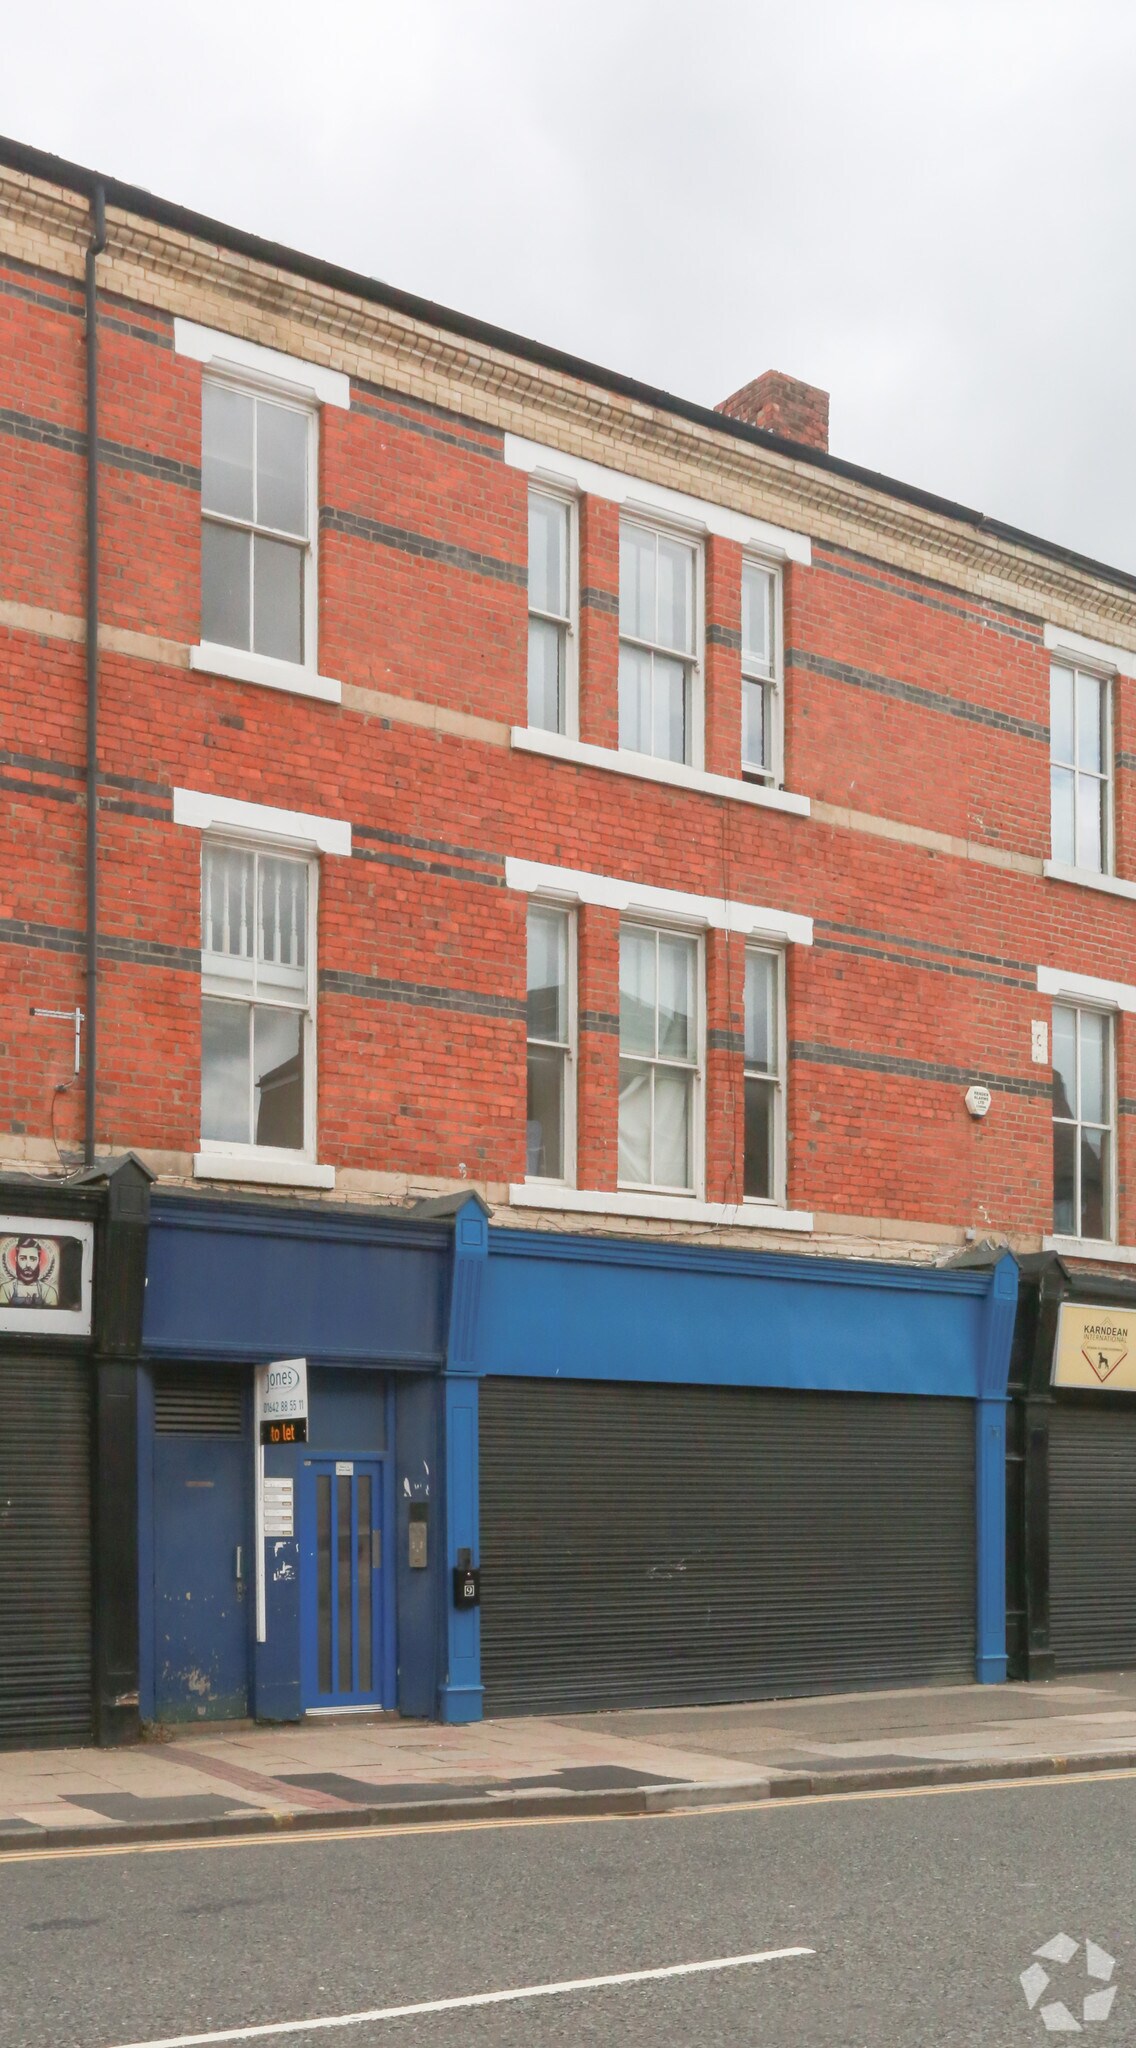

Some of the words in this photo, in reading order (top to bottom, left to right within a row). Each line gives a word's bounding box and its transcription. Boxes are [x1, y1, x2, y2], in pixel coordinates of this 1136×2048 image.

[1084, 1325, 1128, 1337] KARNDEAN
[1083, 1333, 1128, 1343] INTERNATIONAL
[265, 1371, 293, 1394] jones
[263, 1401, 279, 1414] 01642
[281, 1400, 288, 1412] 88
[290, 1399, 297, 1411] 55
[299, 1399, 304, 1410] 11
[271, 1426, 280, 1442] to
[283, 1424, 295, 1441] let
[466, 1586, 473, 1596] 9
